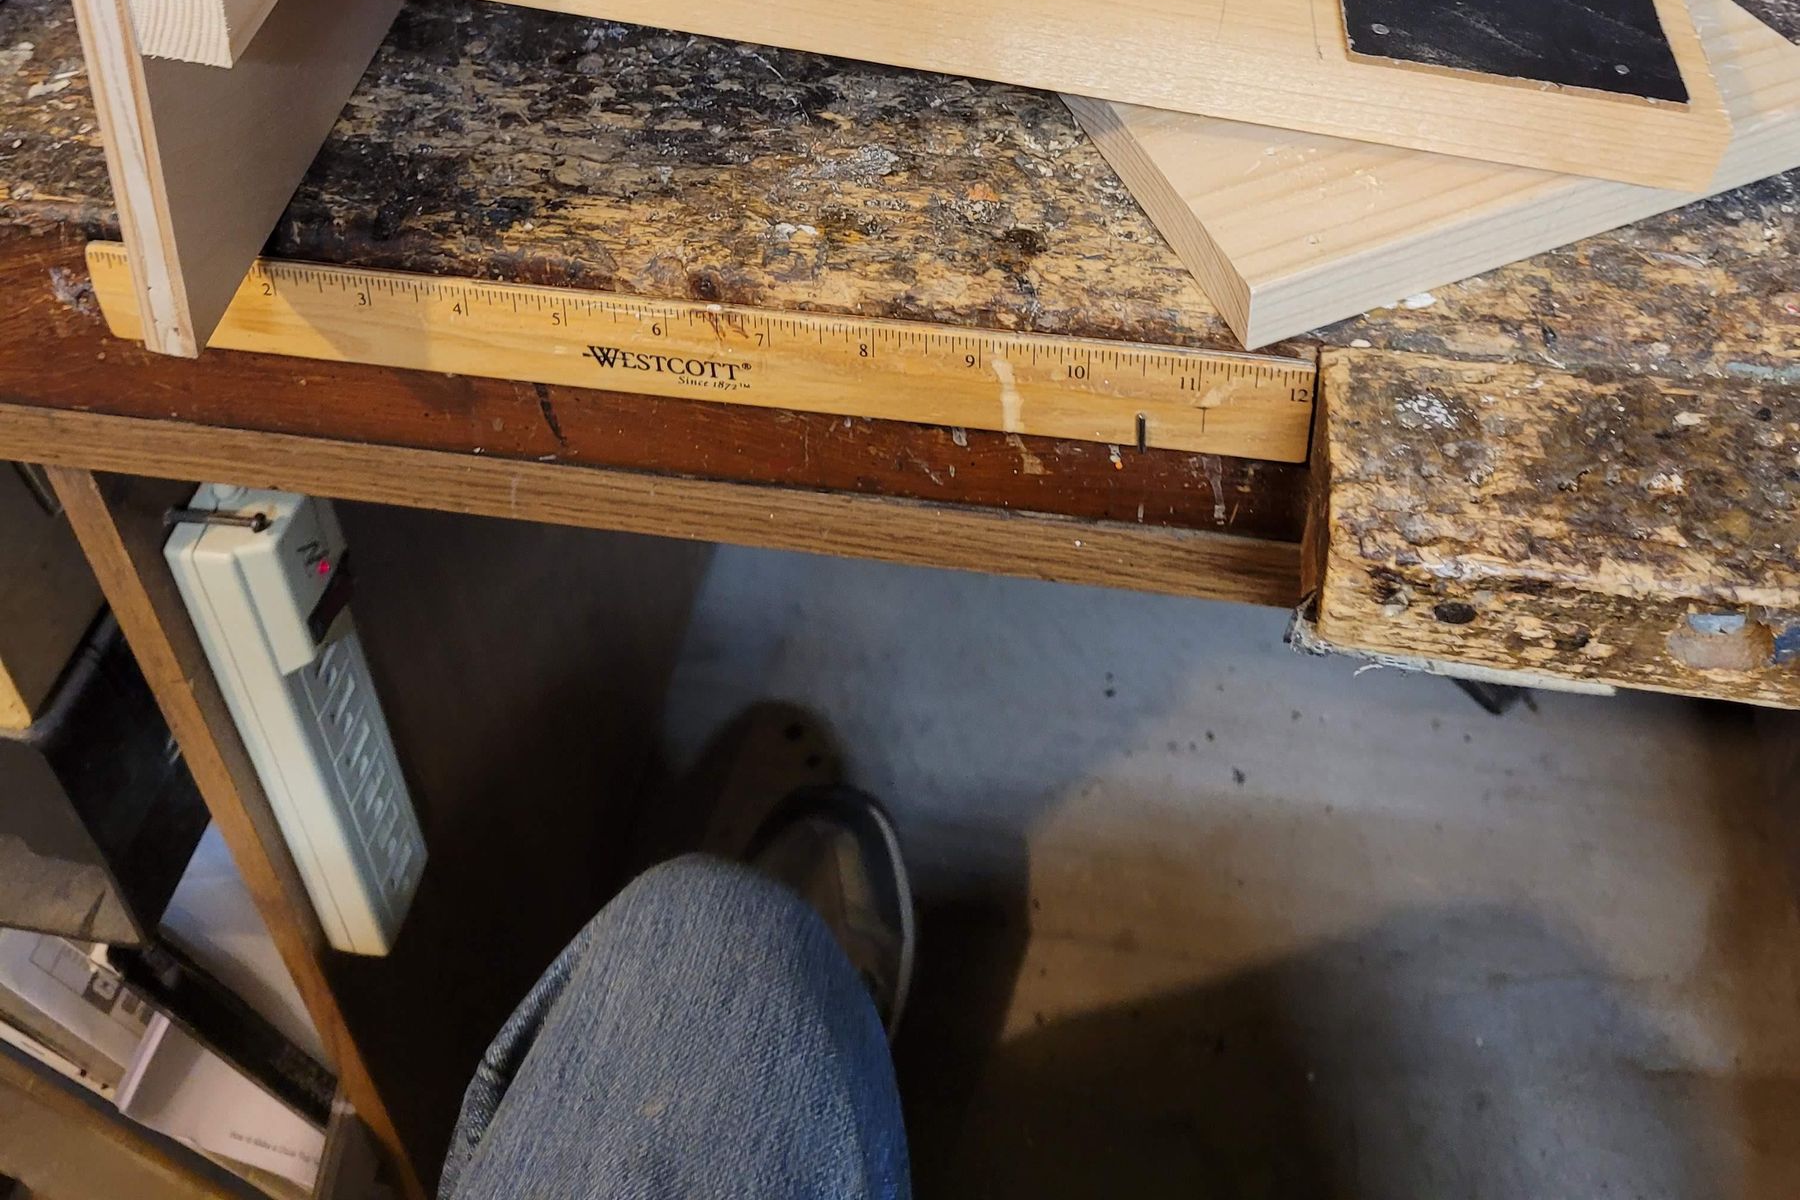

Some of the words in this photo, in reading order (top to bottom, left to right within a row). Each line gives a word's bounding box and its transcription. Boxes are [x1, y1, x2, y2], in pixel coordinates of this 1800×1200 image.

[263, 282, 272, 296] 2
[358, 292, 368, 307] 3
[452, 302, 463, 316] 4
[552, 312, 561, 326] 5
[652, 322, 661, 337] 6
[755, 333, 764, 348] 7
[859, 343, 868, 358] 8
[965, 354, 975, 369] 9
[1067, 364, 1086, 380] 10
[1179, 377, 1195, 392] 11
[1289, 388, 1308, 403] 12
[678, 375, 708, 387] Since
